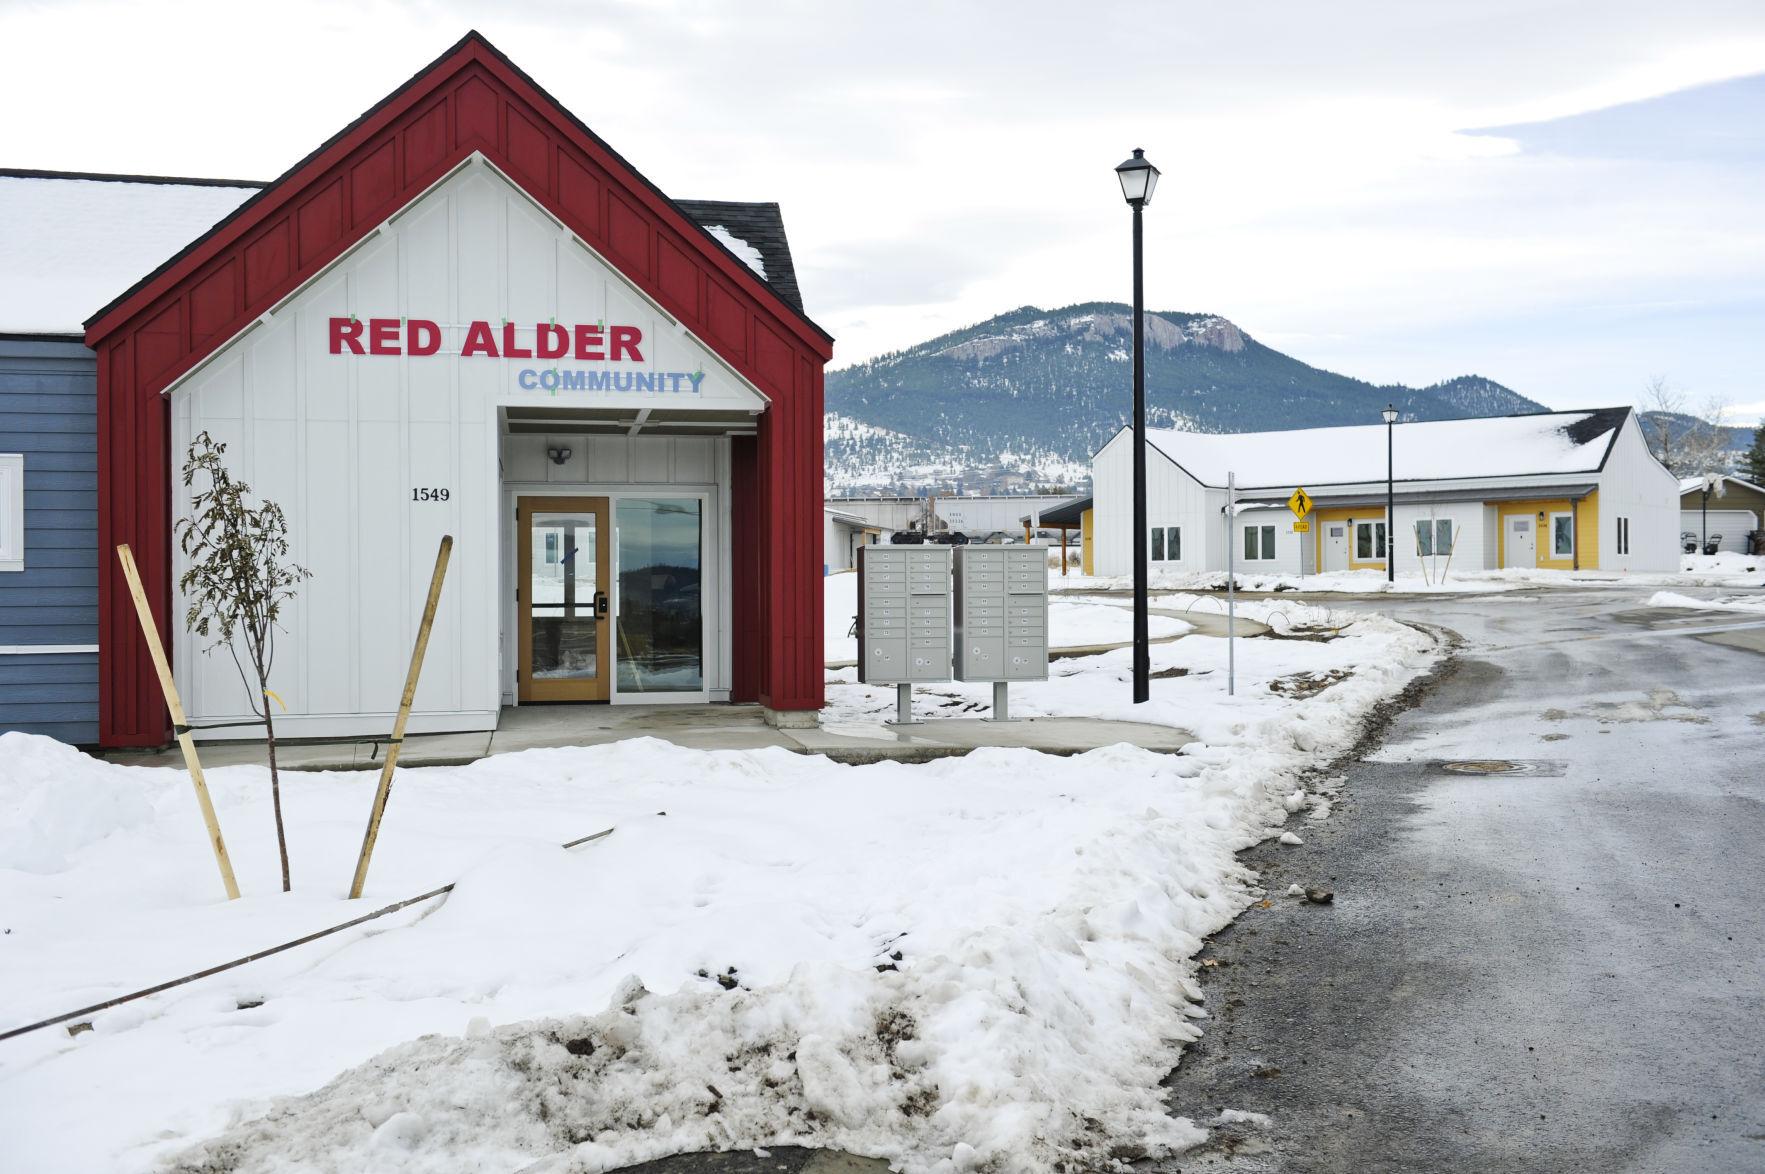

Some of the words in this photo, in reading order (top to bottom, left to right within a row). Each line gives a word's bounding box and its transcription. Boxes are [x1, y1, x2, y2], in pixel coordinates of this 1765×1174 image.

[330, 318, 442, 356] RED
[462, 321, 644, 362] ALDER
[519, 368, 705, 393] COMMUNITY
[412, 487, 450, 501] 1549
